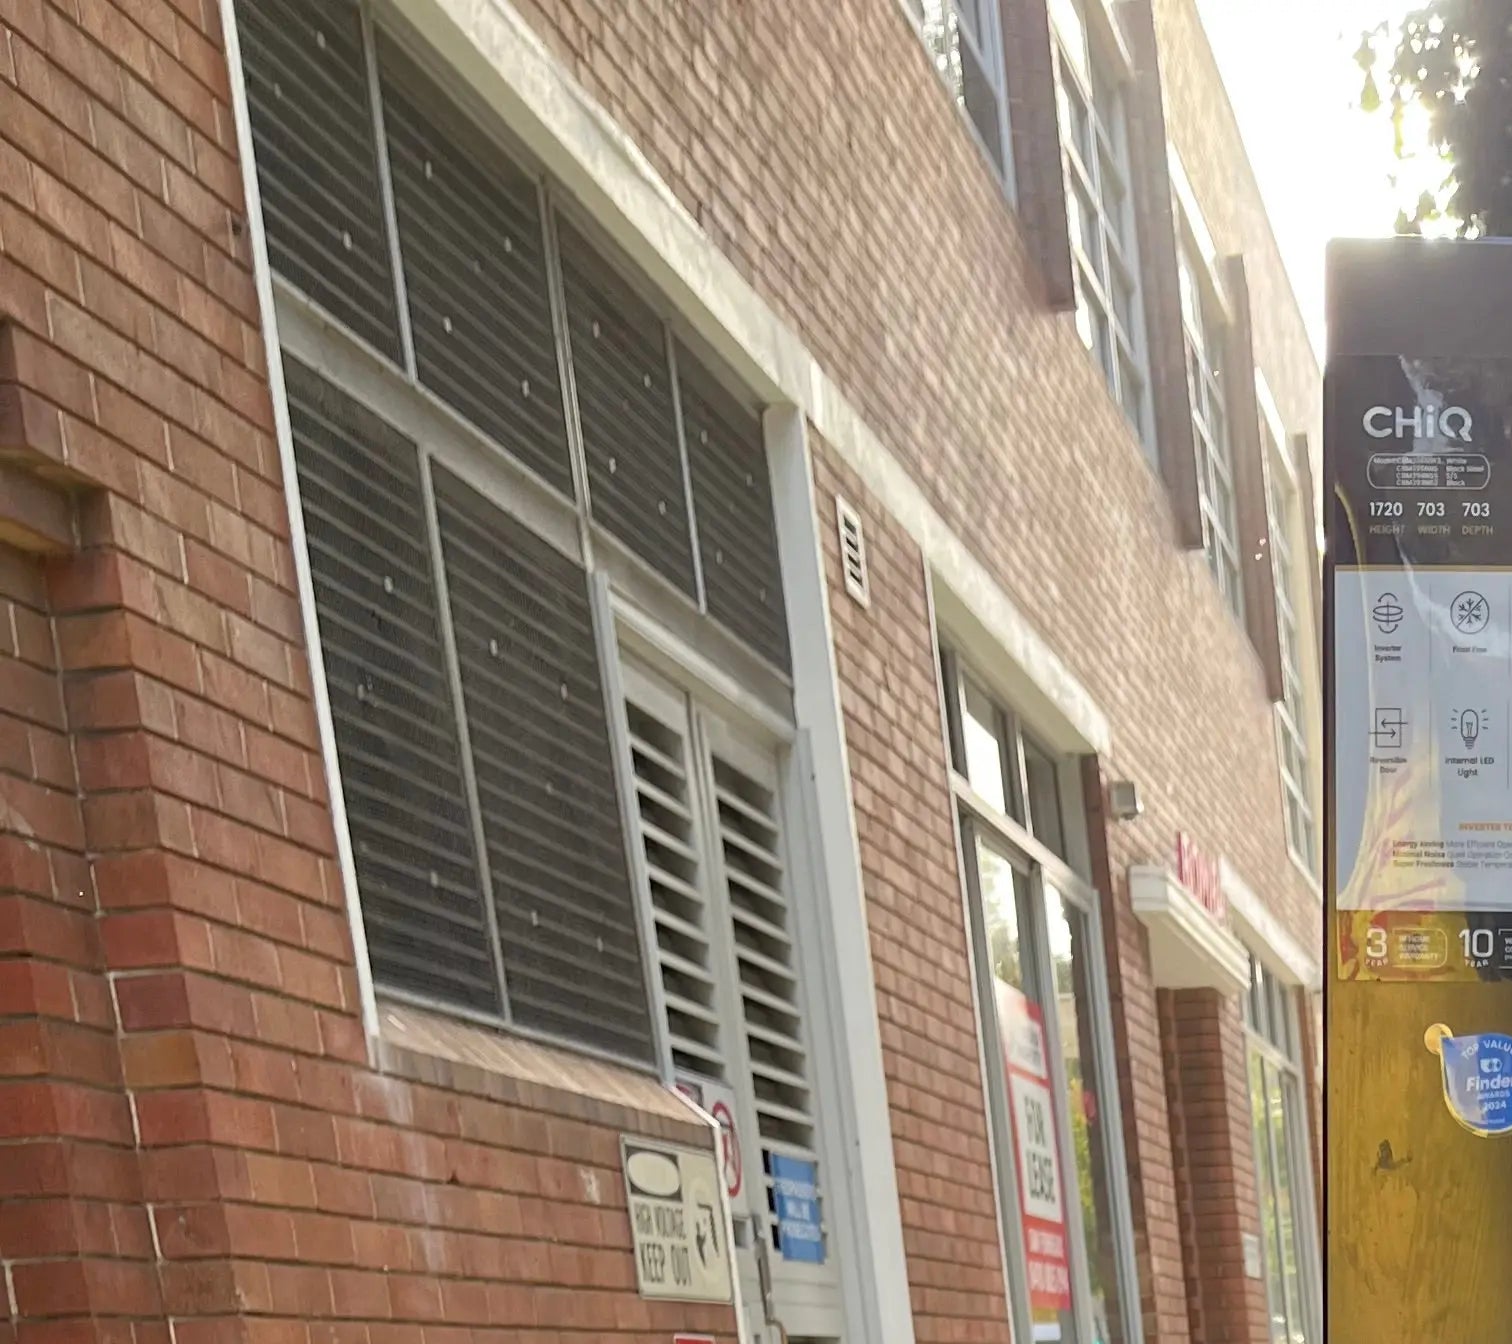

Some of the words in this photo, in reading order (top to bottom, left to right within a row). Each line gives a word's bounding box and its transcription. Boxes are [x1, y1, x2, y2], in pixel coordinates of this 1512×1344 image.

[1362, 405, 1473, 442] CHiQ
[1369, 502, 1403, 517] 1720
[1417, 502, 1445, 517] 703
[1462, 502, 1490, 517] 703
[1461, 525, 1494, 535] DEPTH
[1480, 757, 1495, 765] LED
[1366, 928, 1387, 958] 3
[1459, 929, 1494, 958] 10
[1460, 1043, 1480, 1061] TOP
[640, 1243, 666, 1283] KEEP
[670, 1244, 692, 1286] OUT
